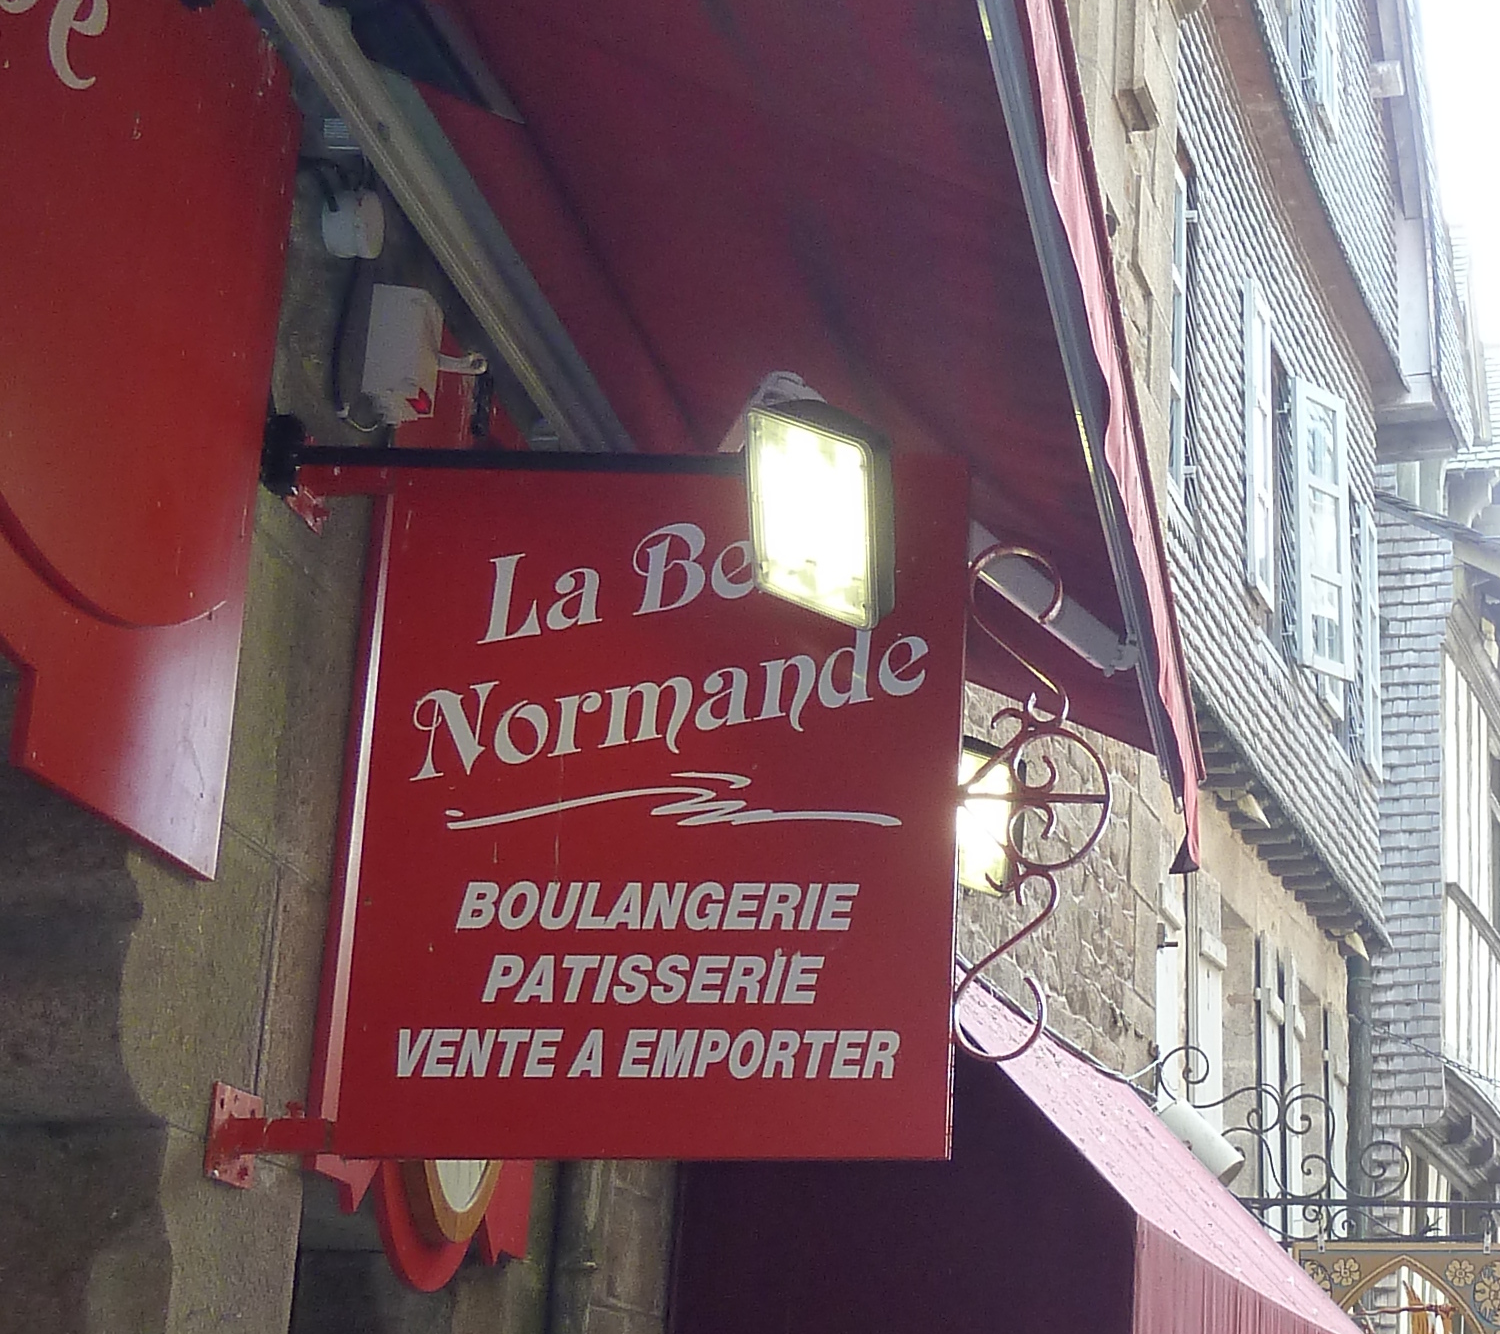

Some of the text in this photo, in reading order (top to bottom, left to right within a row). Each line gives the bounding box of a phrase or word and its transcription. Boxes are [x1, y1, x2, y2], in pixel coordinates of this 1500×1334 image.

[476, 552, 603, 646] La
[408, 629, 930, 782] Normande
[455, 881, 860, 934] BOULANGERIE
[480, 953, 825, 1004] PATISSERIE
[397, 1028, 901, 1080] VENTE A EMPORTER
